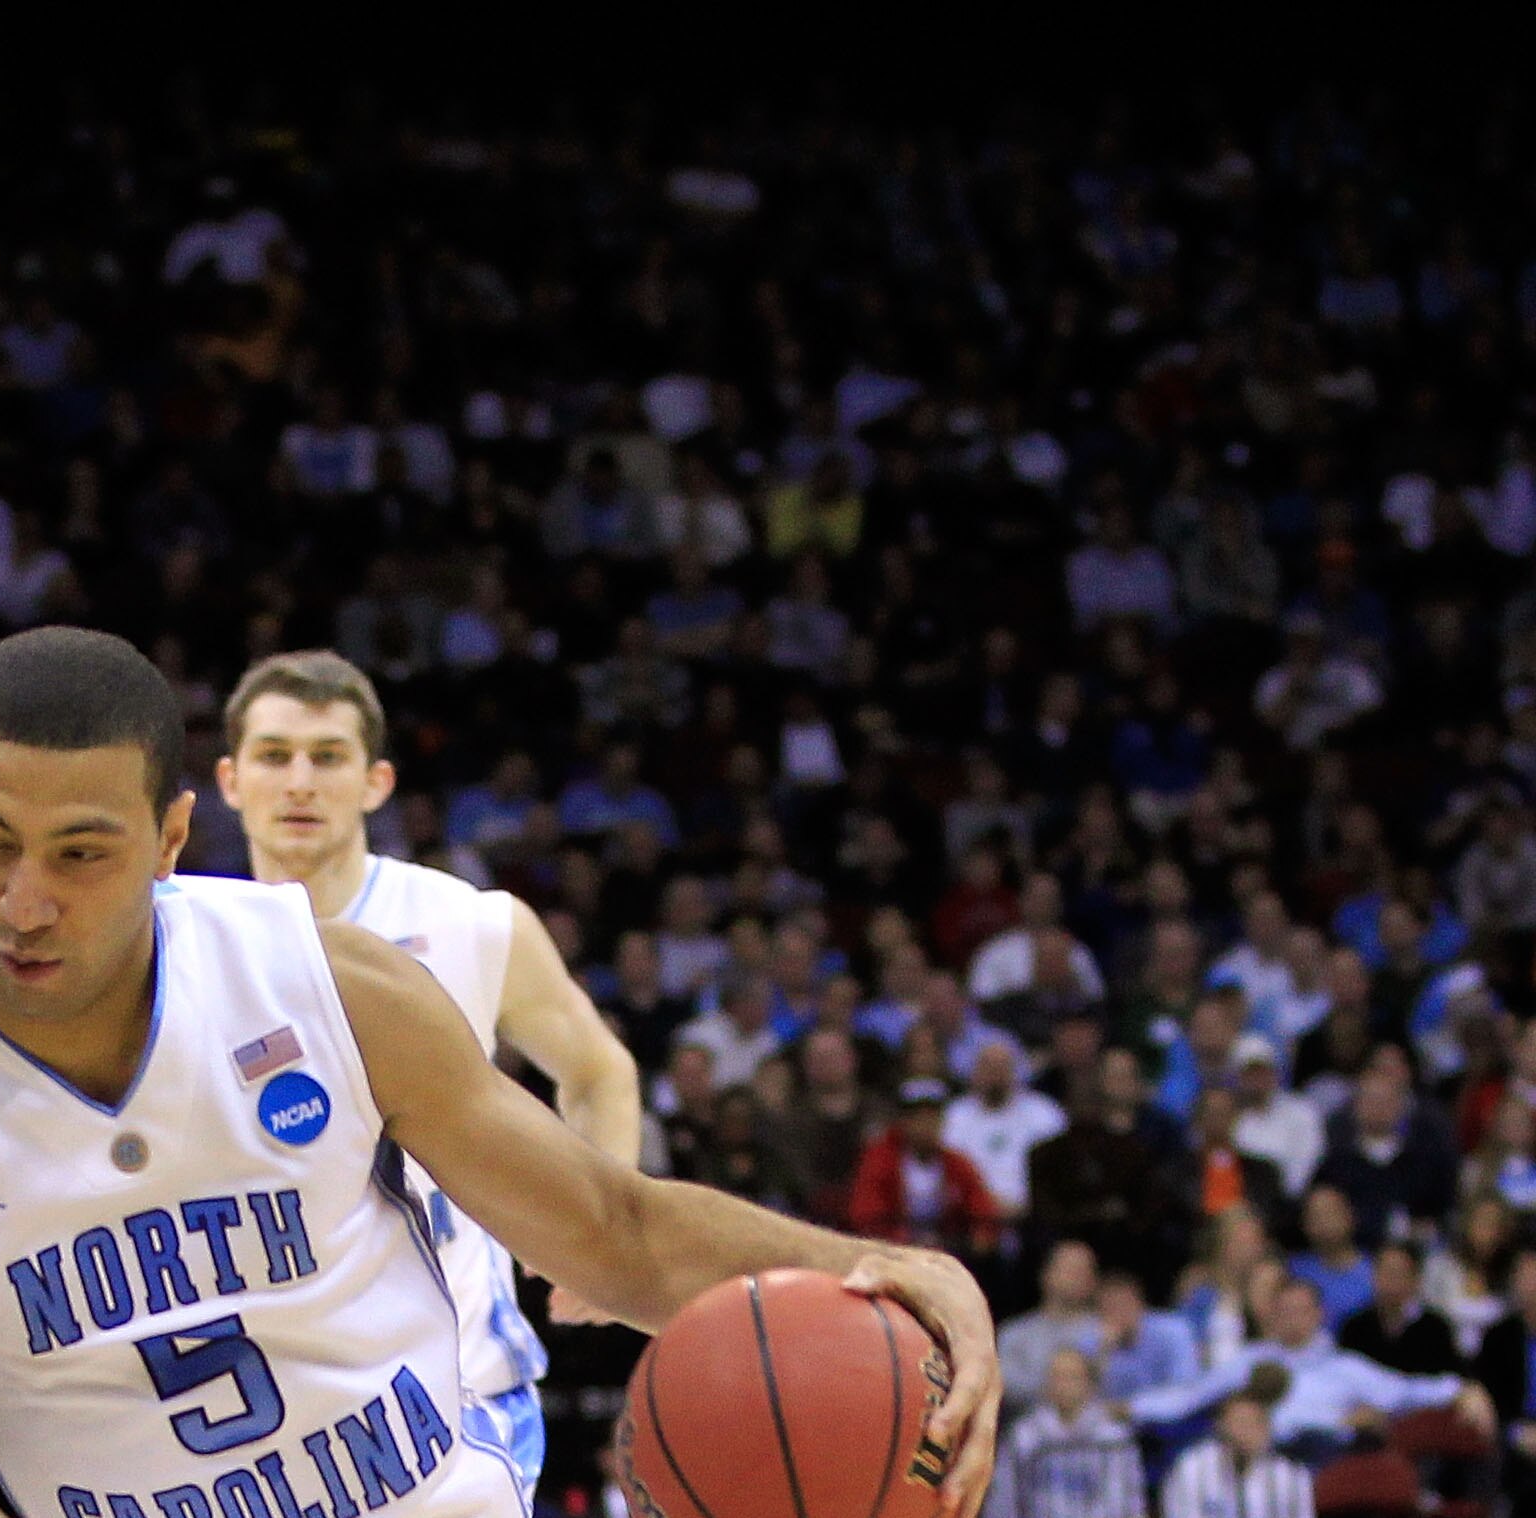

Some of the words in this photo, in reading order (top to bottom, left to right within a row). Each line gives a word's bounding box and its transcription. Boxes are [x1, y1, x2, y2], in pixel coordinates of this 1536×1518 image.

[270, 1095, 325, 1134] NCAA
[6, 1188, 318, 1355] NORTH
[133, 1313, 286, 1457] 5
